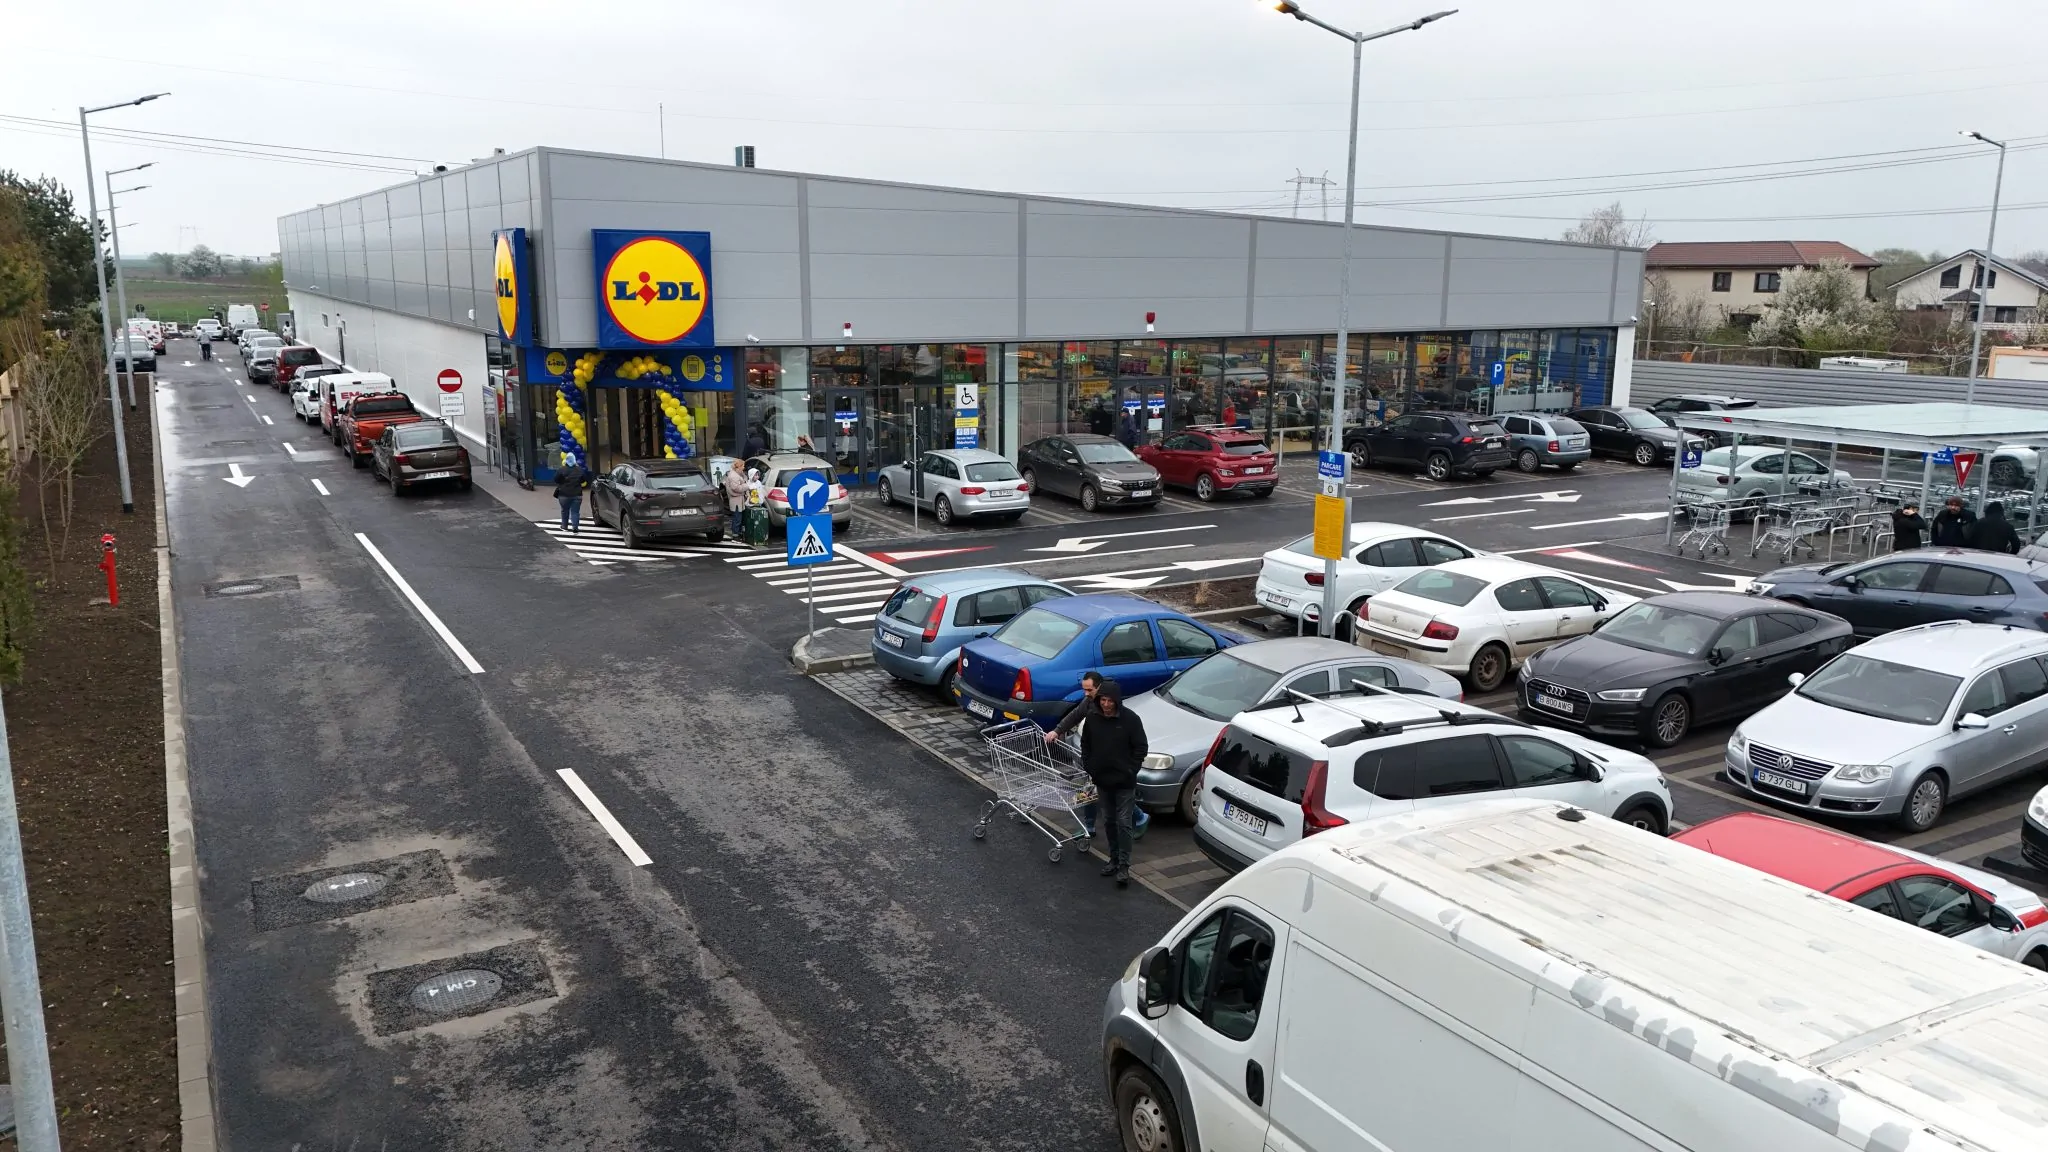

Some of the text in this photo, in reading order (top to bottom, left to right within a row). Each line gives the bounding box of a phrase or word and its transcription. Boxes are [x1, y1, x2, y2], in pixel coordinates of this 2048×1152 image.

[1494, 363, 1502, 378] P
[1321, 462, 1342, 472] PARCARE
[1557, 701, 1572, 712] AWS
[1759, 771, 1803, 792] B 737 GLJ
[1228, 805, 1264, 832] B 759 ATR
